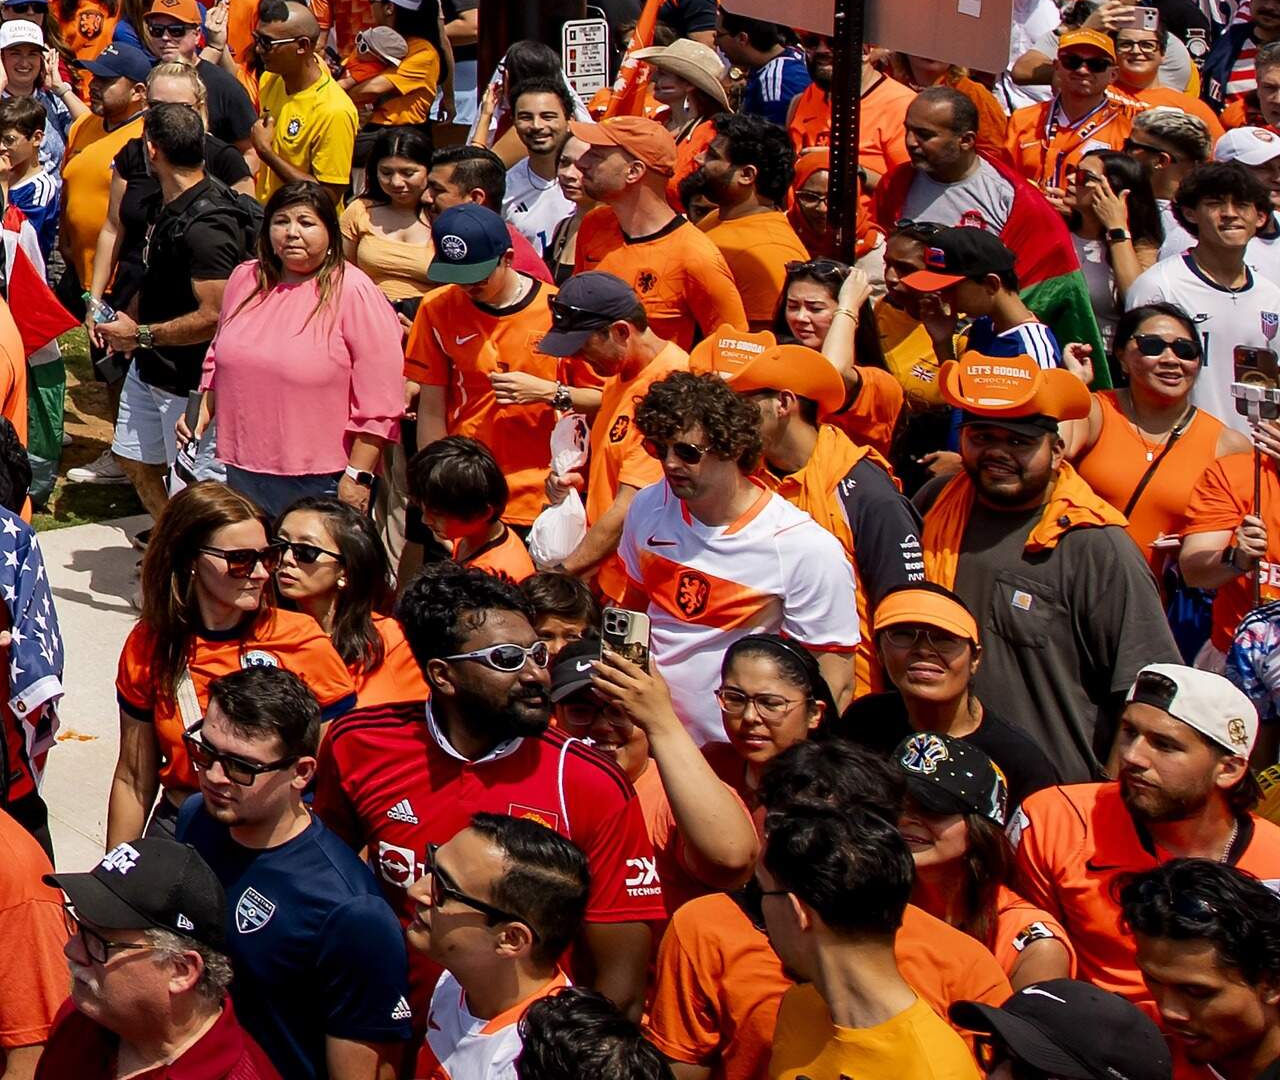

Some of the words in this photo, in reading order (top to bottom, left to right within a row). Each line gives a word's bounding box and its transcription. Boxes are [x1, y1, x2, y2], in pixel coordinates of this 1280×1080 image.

[967, 365, 993, 378] LET'S
[386, 808, 420, 825] adidas
[625, 855, 661, 886] DX
